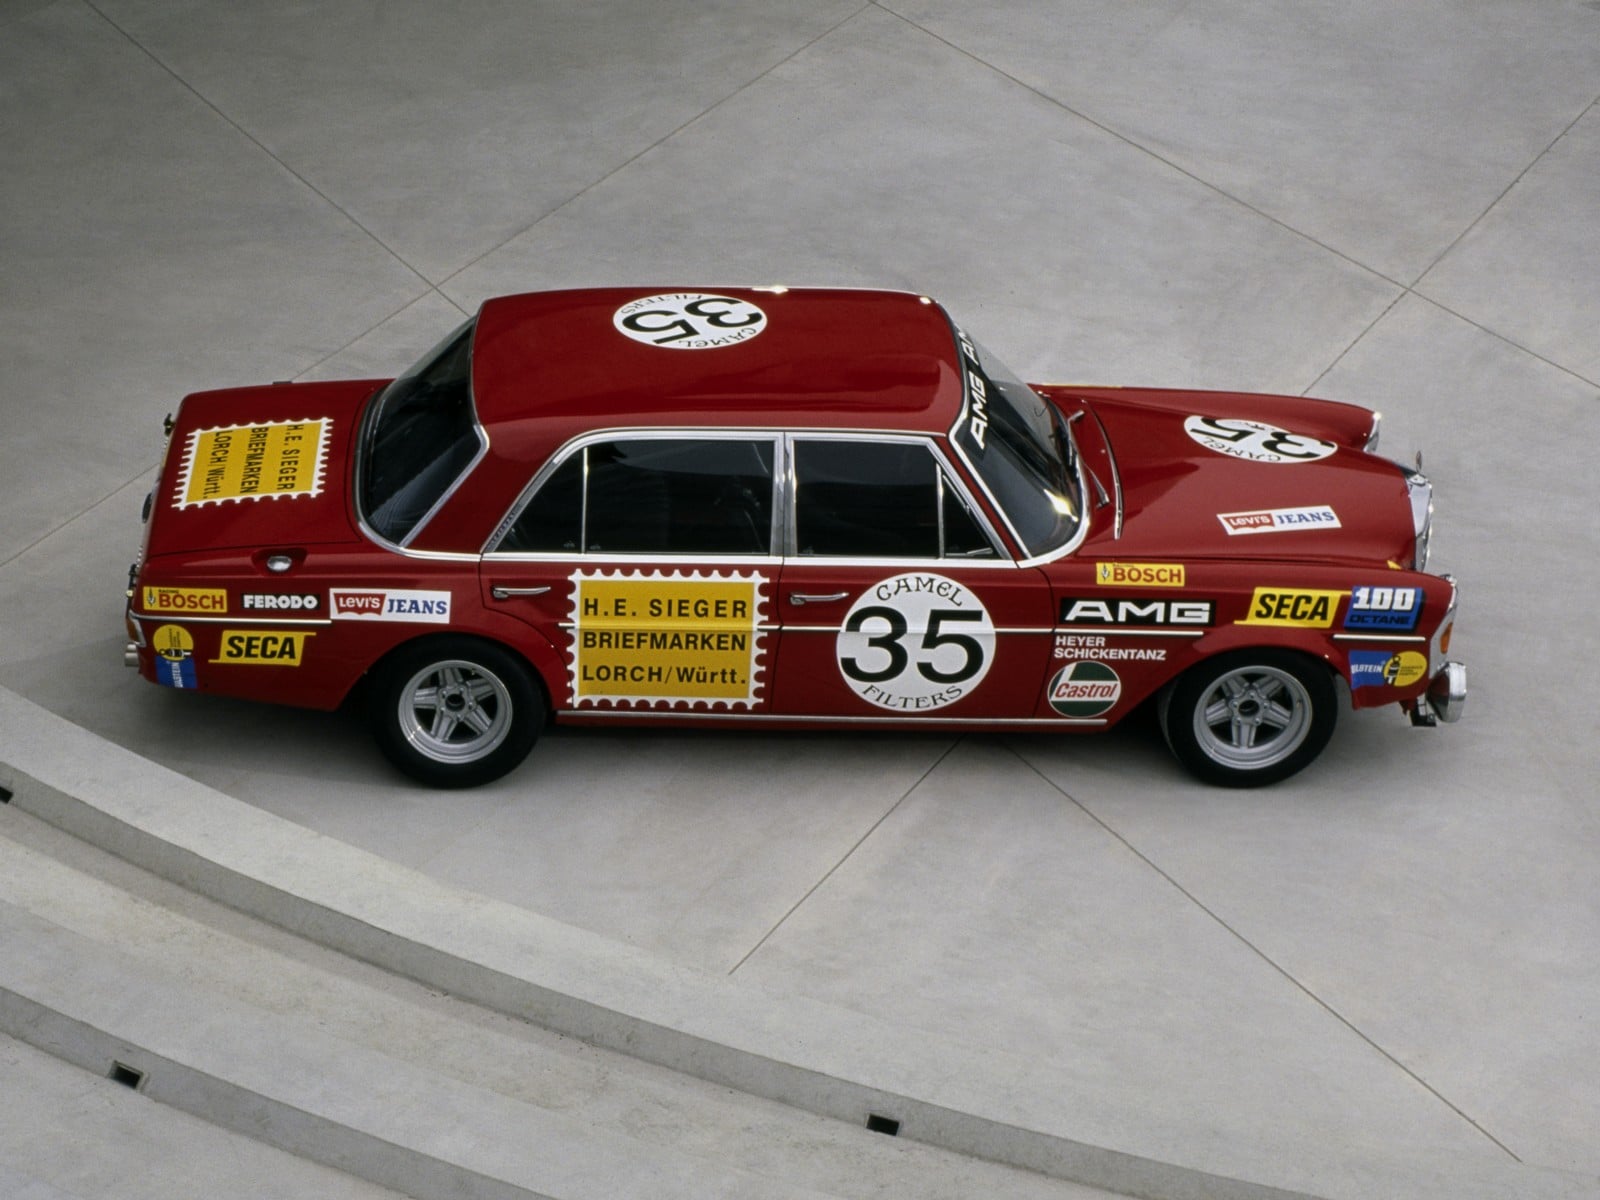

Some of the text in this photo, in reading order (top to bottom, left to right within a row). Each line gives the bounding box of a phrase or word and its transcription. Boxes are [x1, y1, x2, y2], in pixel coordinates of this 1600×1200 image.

[622, 298, 762, 344] 35
[679, 327, 757, 347] CAMEL
[970, 371, 988, 449] AMG
[1190, 417, 1335, 458] 35
[277, 424, 305, 490] H.E. SIEGER
[1203, 437, 1281, 461] CAMEL
[240, 427, 269, 494] BRIEFMARKEN
[1276, 511, 1335, 524] JEANS
[1113, 567, 1182, 583] BOSCH
[158, 593, 225, 610] BOSCH
[243, 594, 318, 609] FERODO
[876, 577, 963, 607] CAMEL
[1353, 587, 1416, 610] 100
[387, 598, 448, 615] JEANS
[583, 598, 747, 618] H.E. SIEGER
[1065, 600, 1211, 623] AMG
[1255, 593, 1329, 621] SECA
[1349, 614, 1411, 625] OCTANE
[226, 635, 296, 660] SECA
[583, 631, 747, 651] BRIEFMARKEN
[840, 606, 984, 684] 35
[1055, 635, 1106, 647] HEYER
[1054, 647, 1167, 660] SCHICKENTANZ
[582, 665, 747, 684] LORCH/Württ.
[862, 685, 963, 709] FILTERS
[1054, 682, 1118, 698] Castrol
